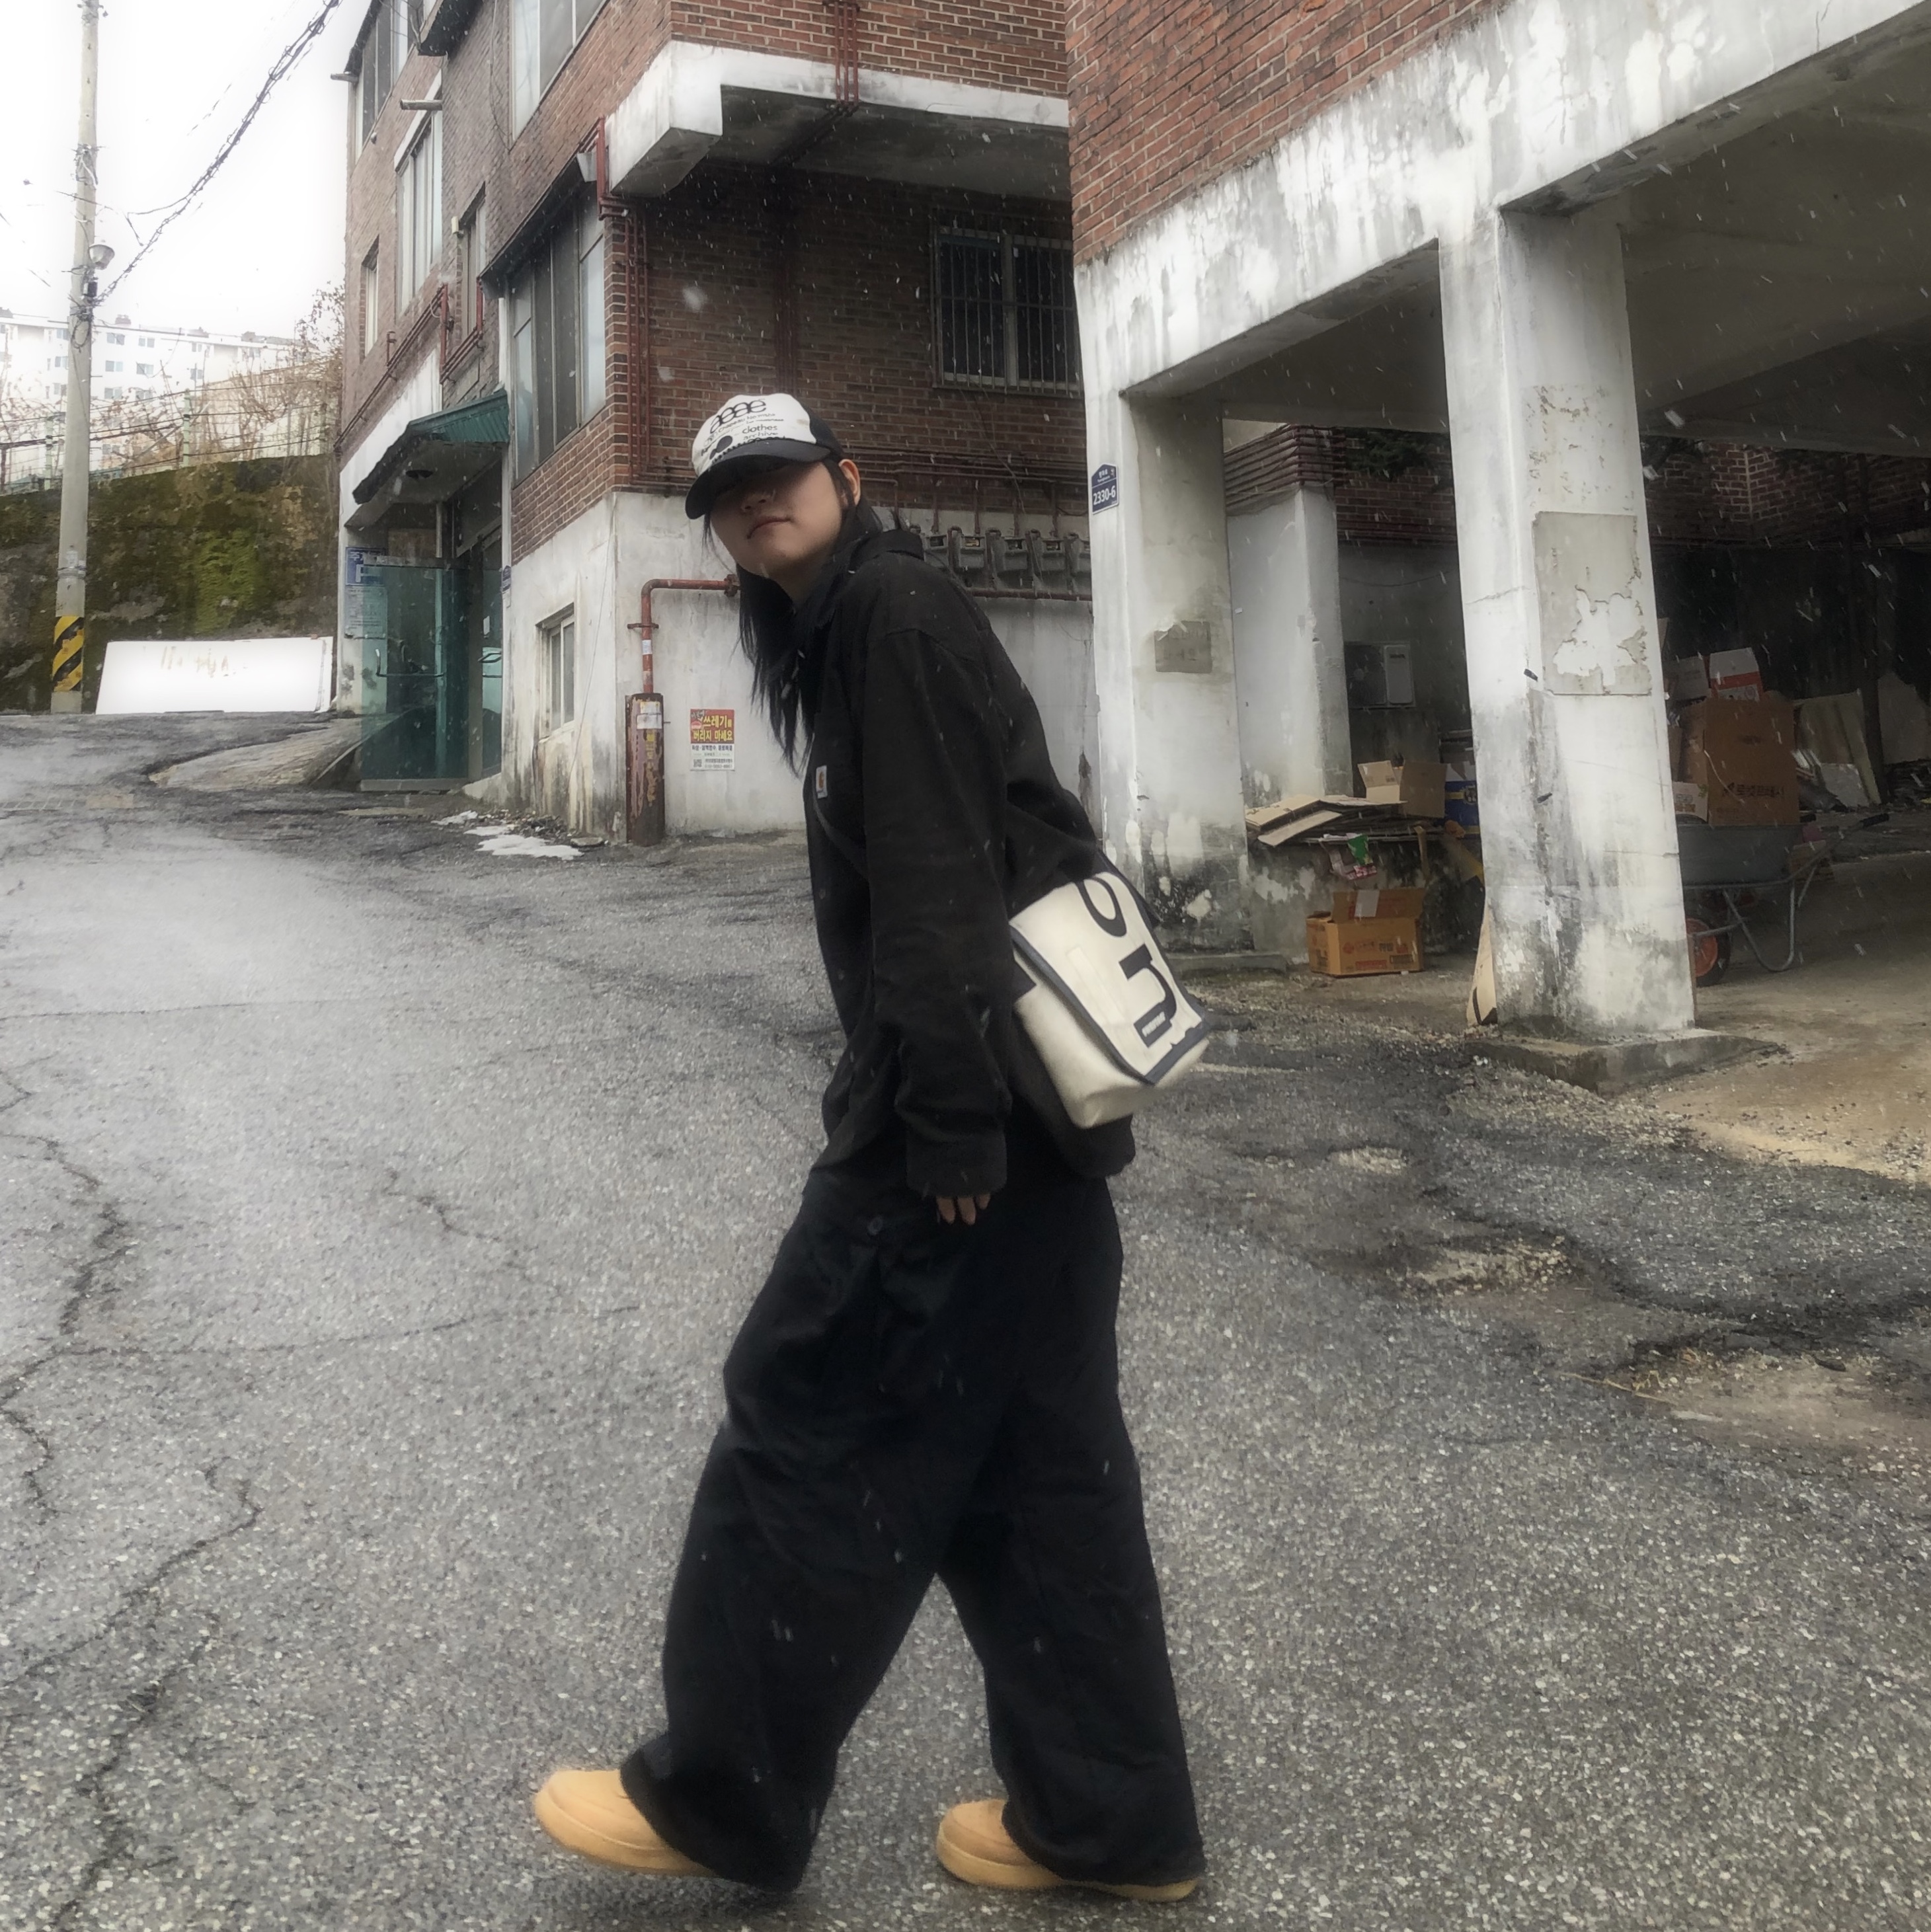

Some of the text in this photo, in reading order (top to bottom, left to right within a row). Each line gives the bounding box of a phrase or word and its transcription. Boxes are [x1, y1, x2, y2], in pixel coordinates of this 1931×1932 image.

[742, 424, 777, 434] clothes
[1093, 485, 1116, 506] 2330-6
[703, 715, 732, 728] 쓰레기를
[693, 729, 732, 742] 버리지 마세요
